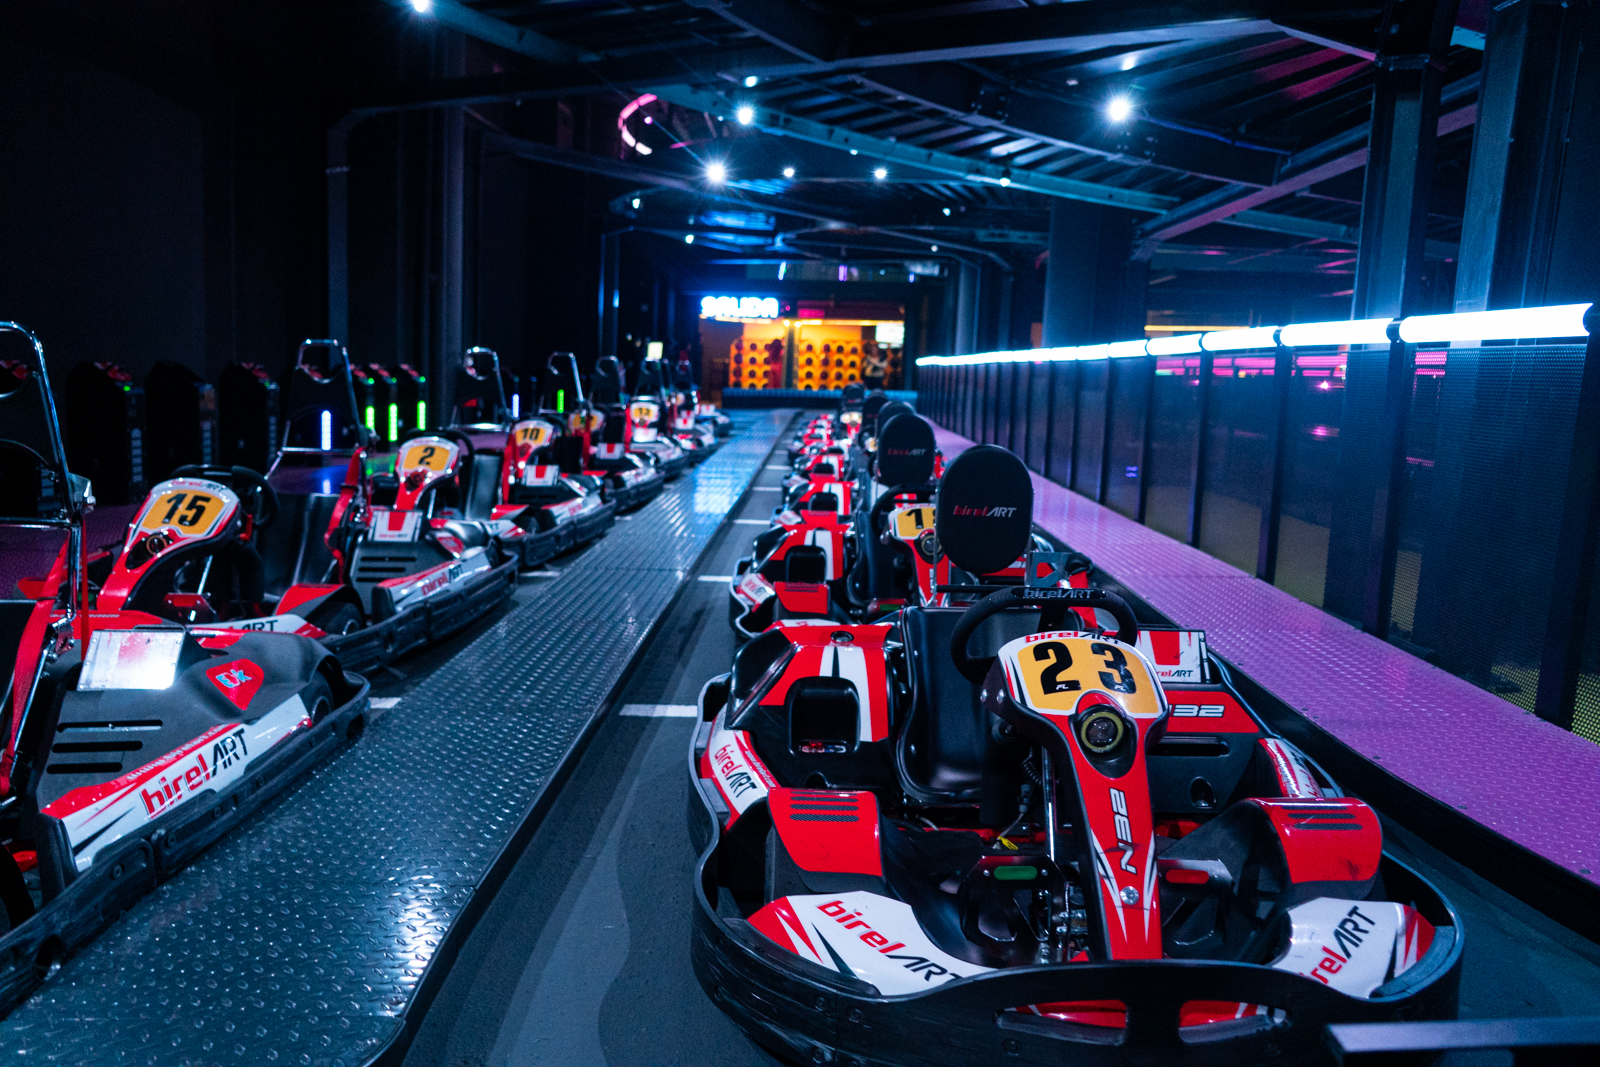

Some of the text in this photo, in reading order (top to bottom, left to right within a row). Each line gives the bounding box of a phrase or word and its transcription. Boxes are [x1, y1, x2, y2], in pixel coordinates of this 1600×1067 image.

[521, 428, 541, 441] 10
[418, 446, 435, 465] 2
[162, 493, 212, 526] 15
[906, 508, 937, 529] 1
[952, 505, 1017, 518] birelART
[1023, 588, 1095, 599] birelART
[1033, 641, 1137, 695] 23
[1156, 669, 1194, 678] relART
[1168, 704, 1225, 718] 32
[139, 728, 248, 819] birelART
[714, 744, 758, 798] birelART
[1109, 787, 1137, 875] N32
[1309, 905, 1376, 984] relART
